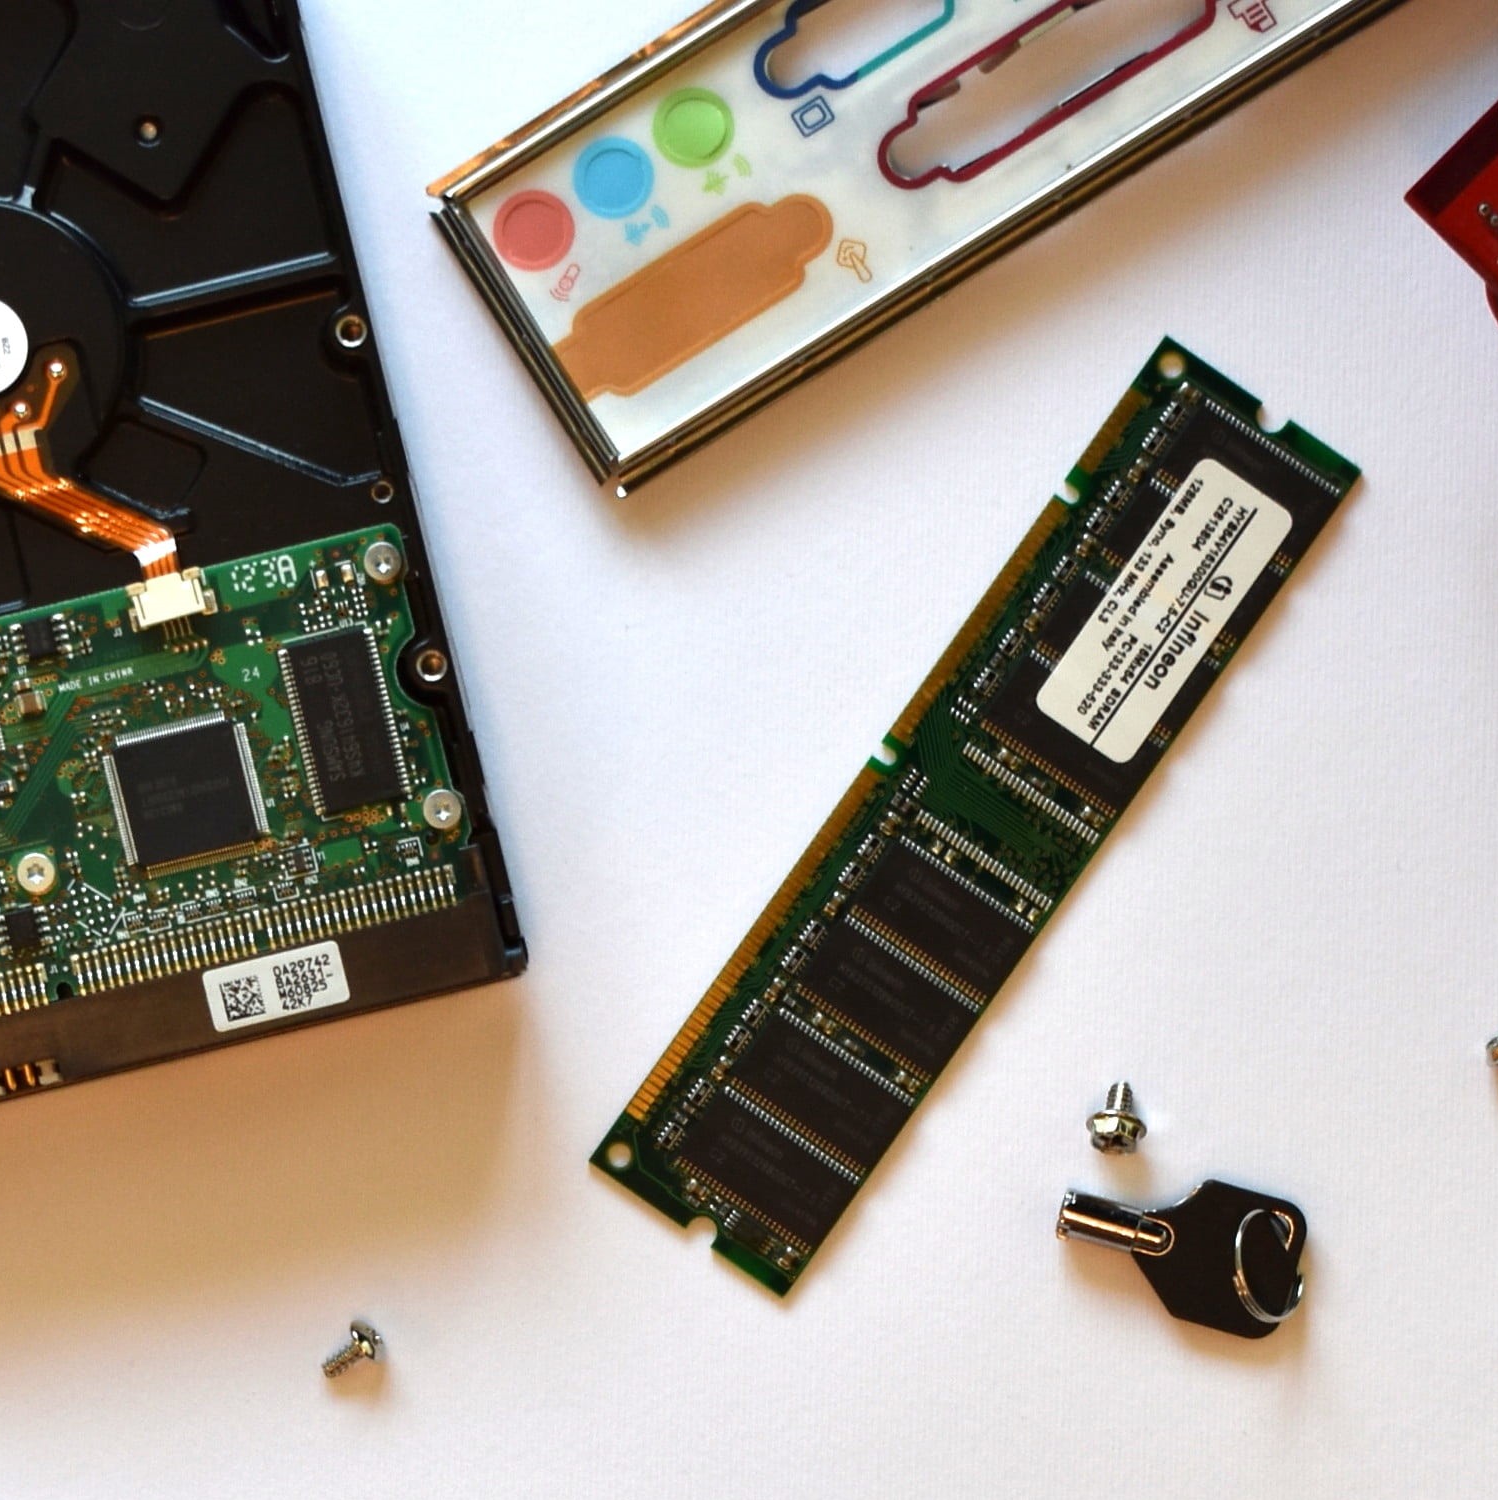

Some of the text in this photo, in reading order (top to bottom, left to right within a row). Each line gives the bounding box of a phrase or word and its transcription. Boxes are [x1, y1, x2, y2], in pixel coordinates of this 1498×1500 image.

[1132, 549, 1153, 572] 133
[1126, 551, 1175, 616] Assembled
[1096, 598, 1119, 624] CL3
[1098, 624, 1124, 653] Italy
[1141, 607, 1211, 695] Infineon
[57, 666, 133, 692] MADE IN CHINA
[241, 666, 261, 682] 24
[1086, 686, 1121, 731] SDRAM
[315, 718, 347, 783] SAMSUNG
[271, 953, 330, 977] 0A29742
